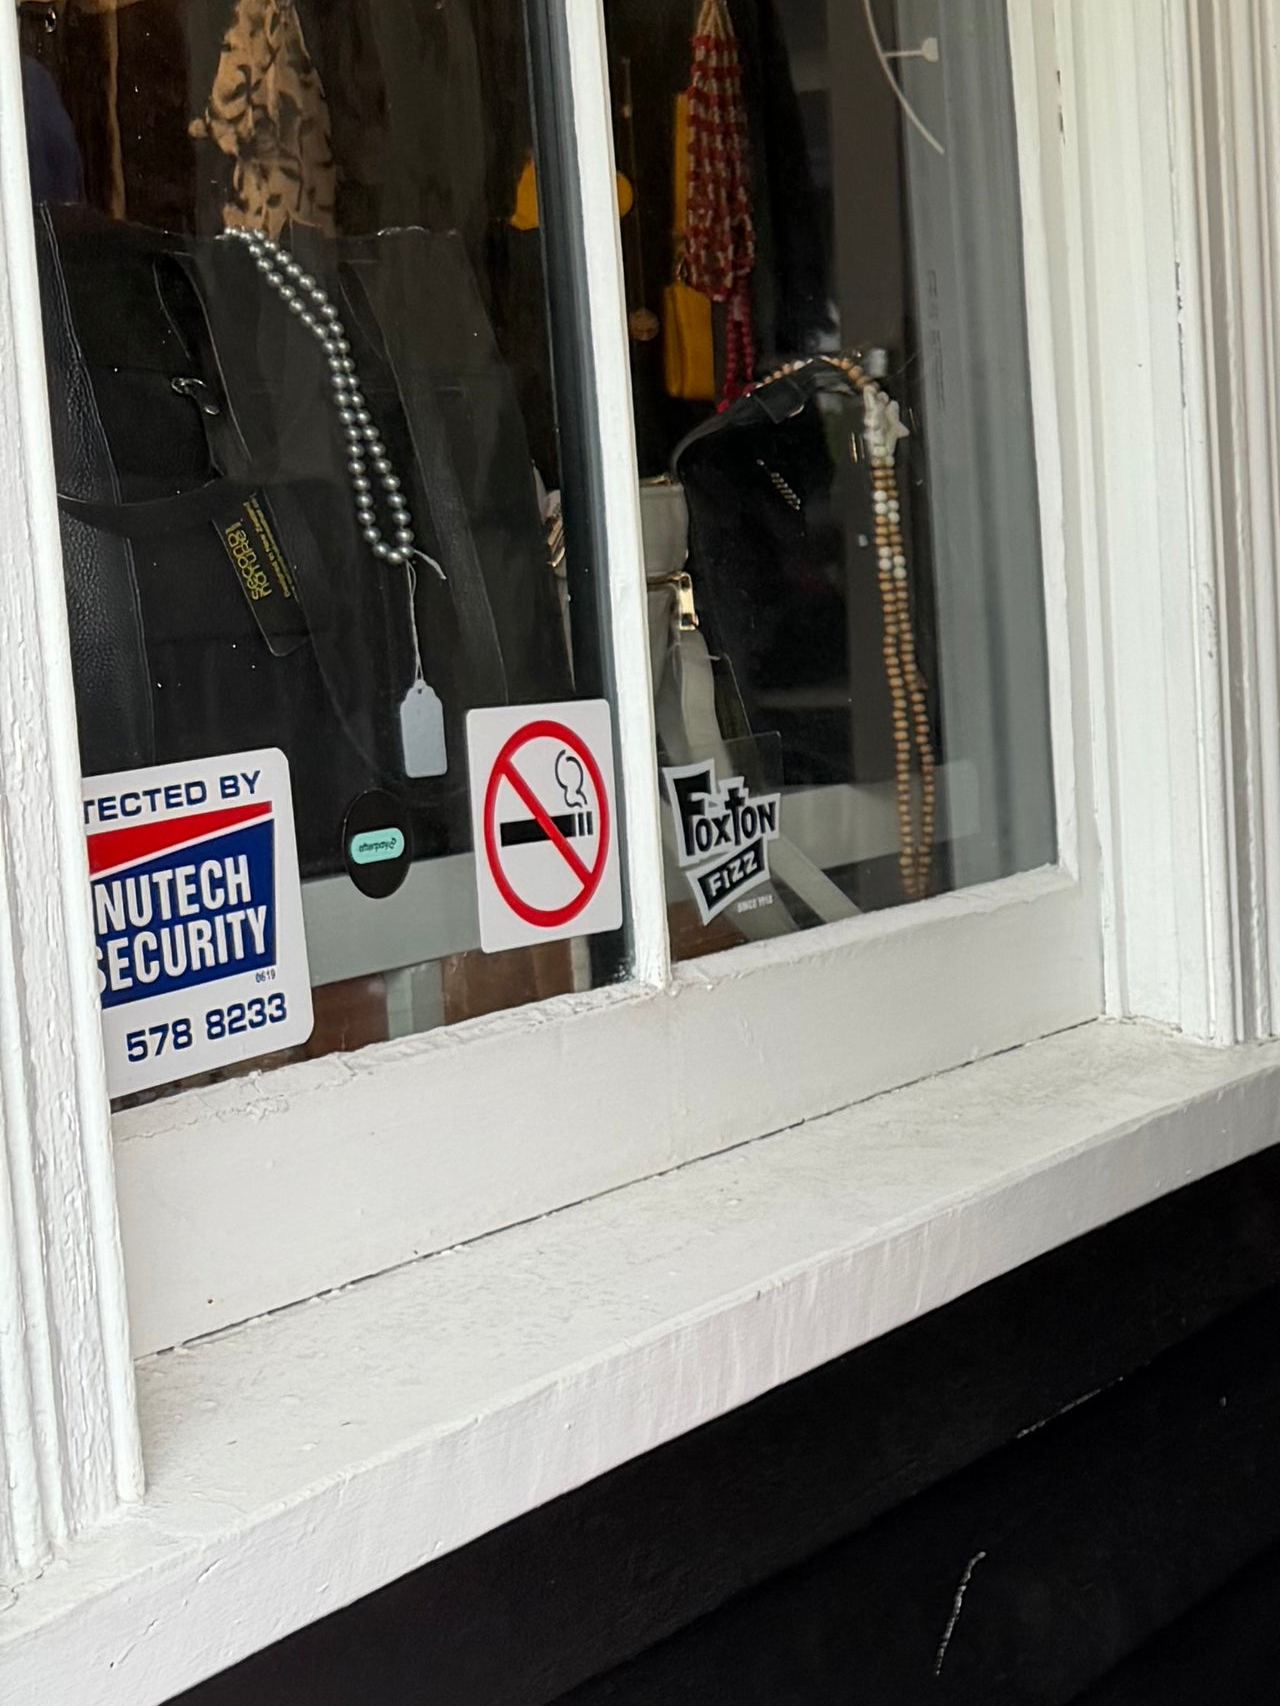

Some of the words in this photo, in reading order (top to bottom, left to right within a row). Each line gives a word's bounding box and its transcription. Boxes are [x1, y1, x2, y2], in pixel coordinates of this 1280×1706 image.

[220, 770, 261, 800] BY
[94, 854, 252, 935] NUTECH
[708, 851, 758, 897] FIZZ
[126, 1018, 193, 1062] 578
[205, 992, 288, 1040] 8233
